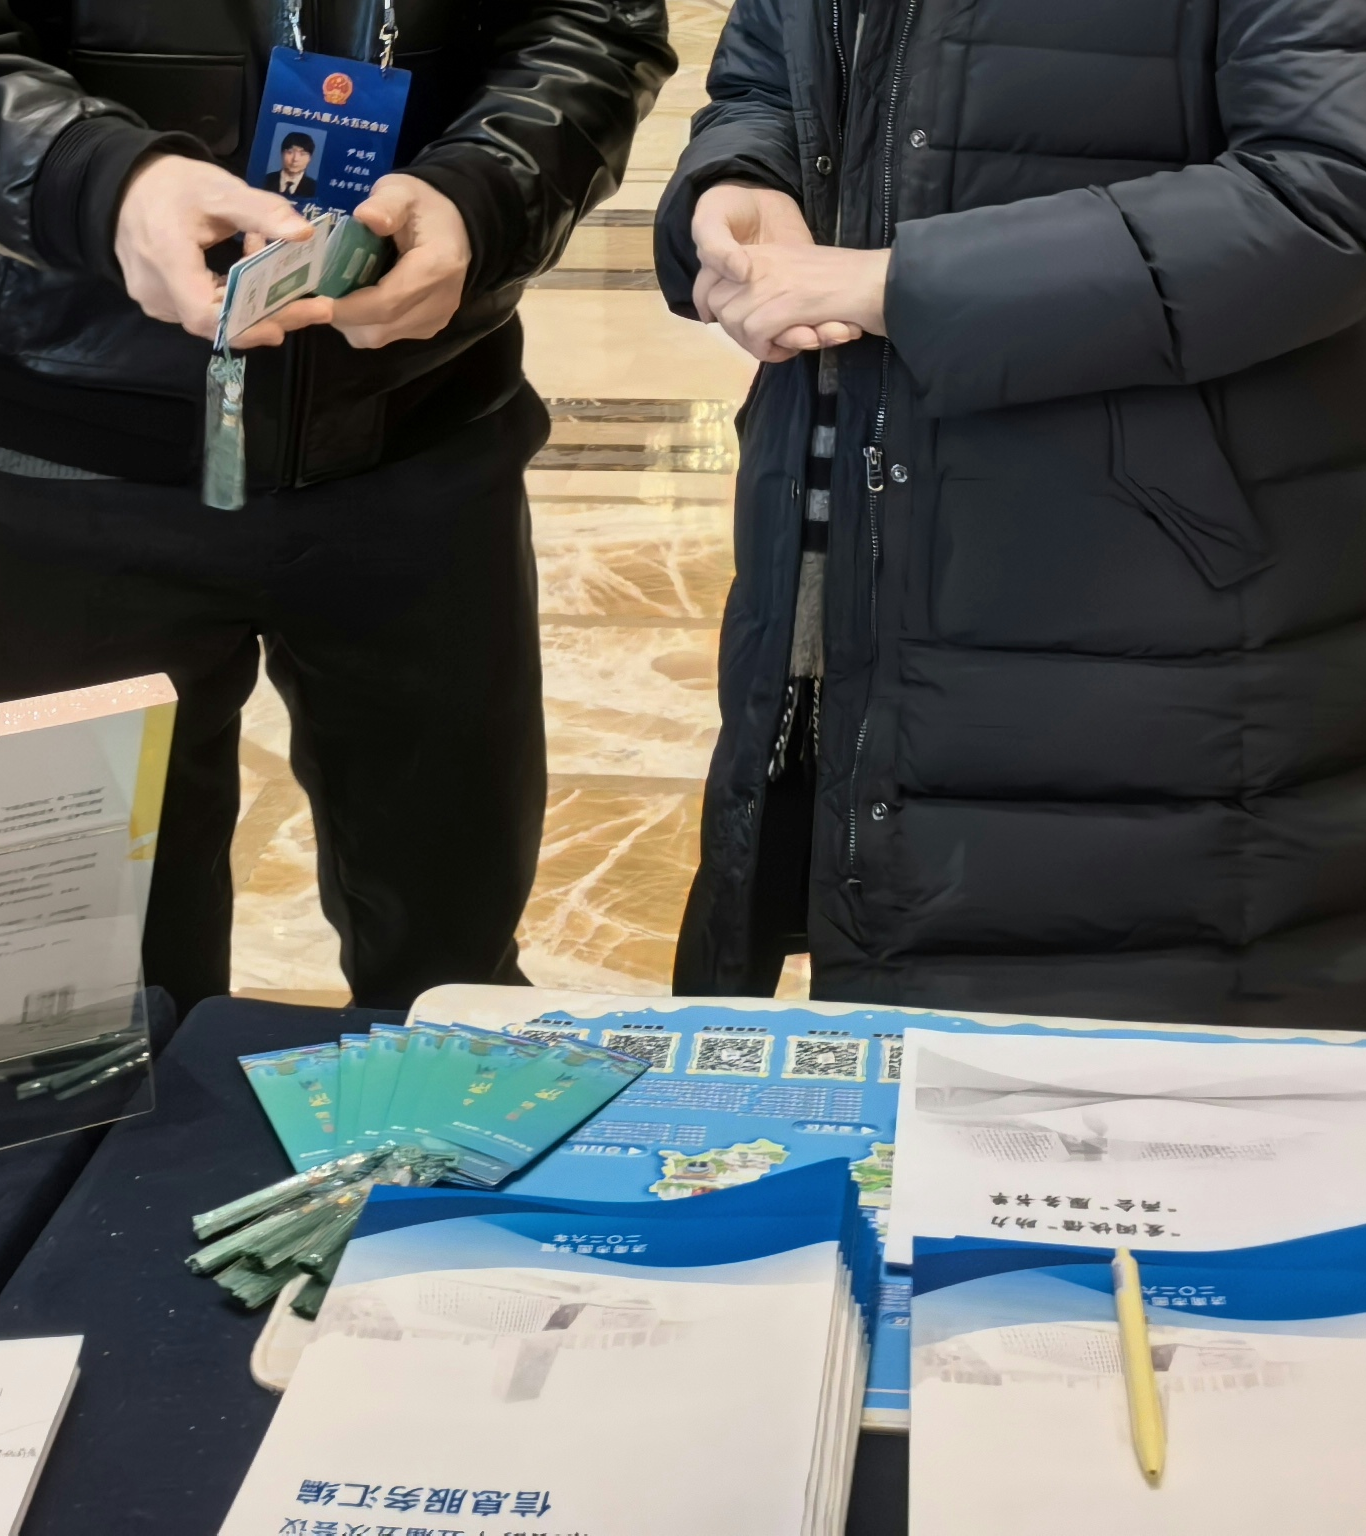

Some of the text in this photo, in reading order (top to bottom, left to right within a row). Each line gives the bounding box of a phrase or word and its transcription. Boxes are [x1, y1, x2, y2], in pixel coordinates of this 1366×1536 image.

[1141, 1285, 1216, 1295] 二〇二六
[295, 1478, 552, 1518] 信息服务汇编
